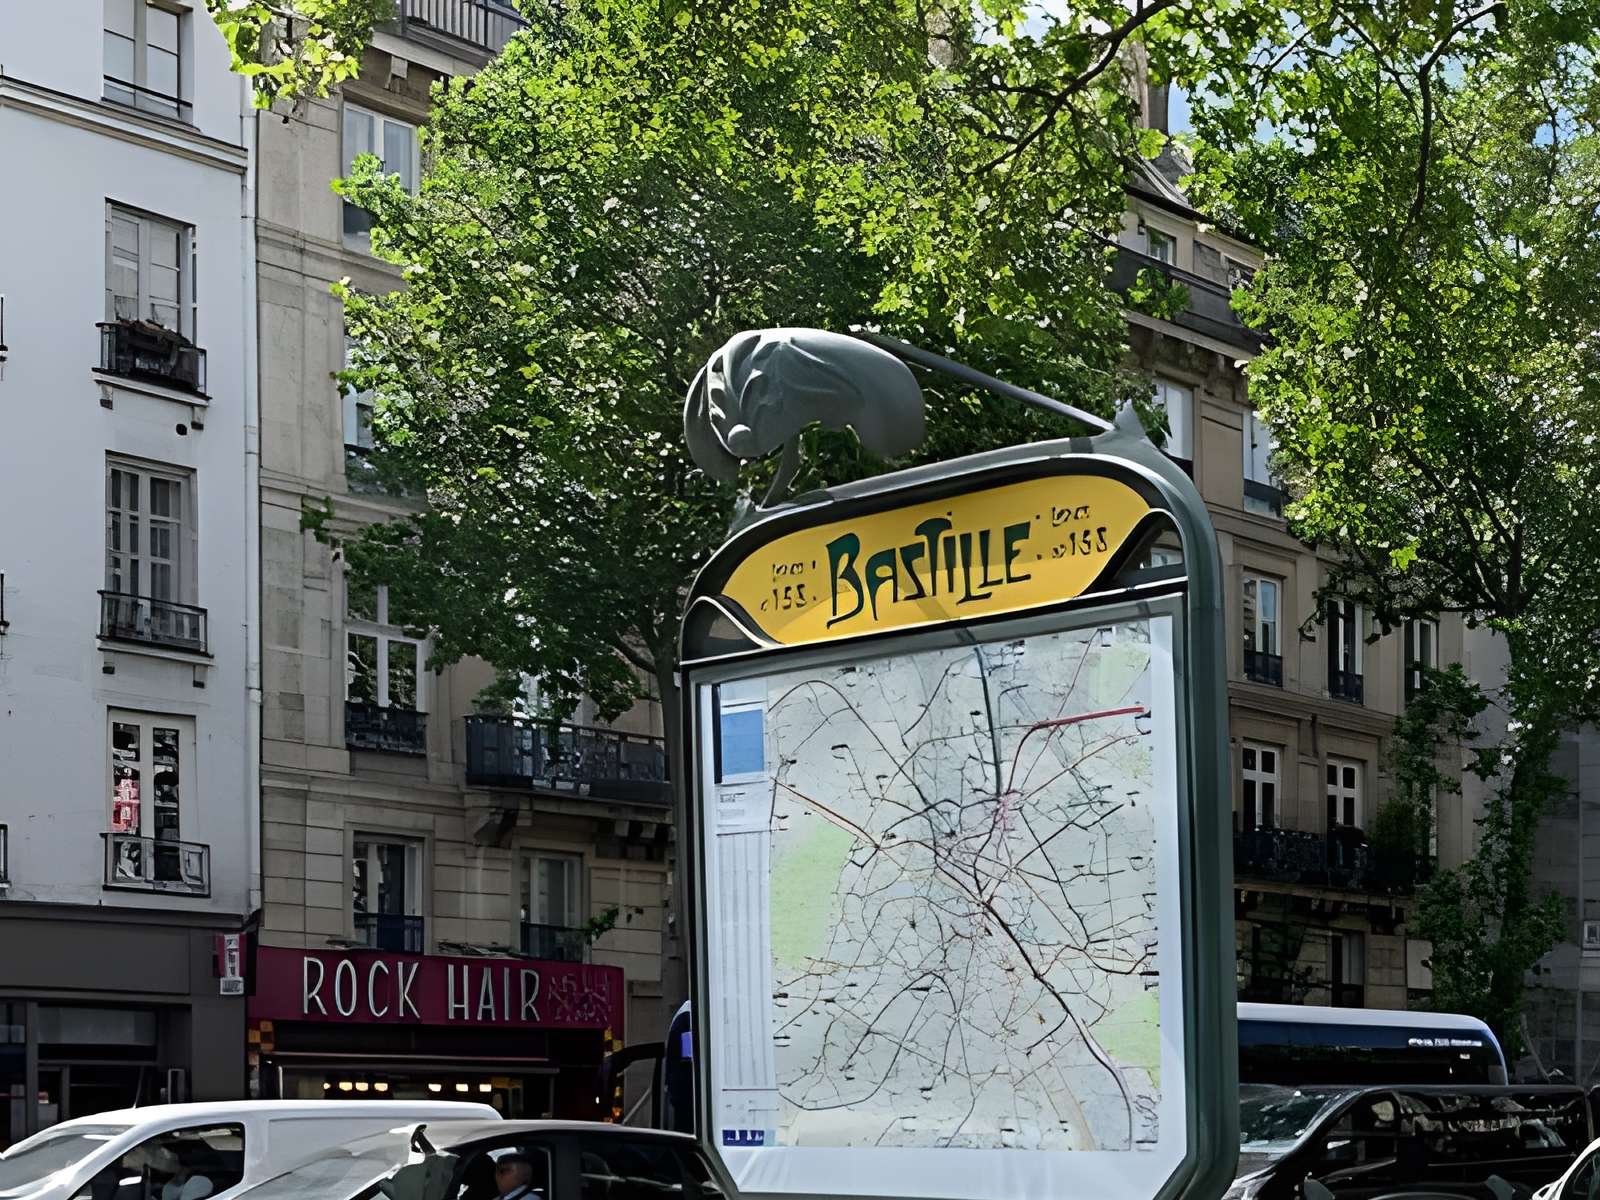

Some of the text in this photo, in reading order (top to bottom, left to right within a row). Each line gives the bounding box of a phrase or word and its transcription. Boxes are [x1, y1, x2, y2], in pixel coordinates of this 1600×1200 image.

[825, 513, 1031, 630] BASTILLE
[303, 955, 421, 1019] ROCK
[447, 964, 541, 1022] HAIR
